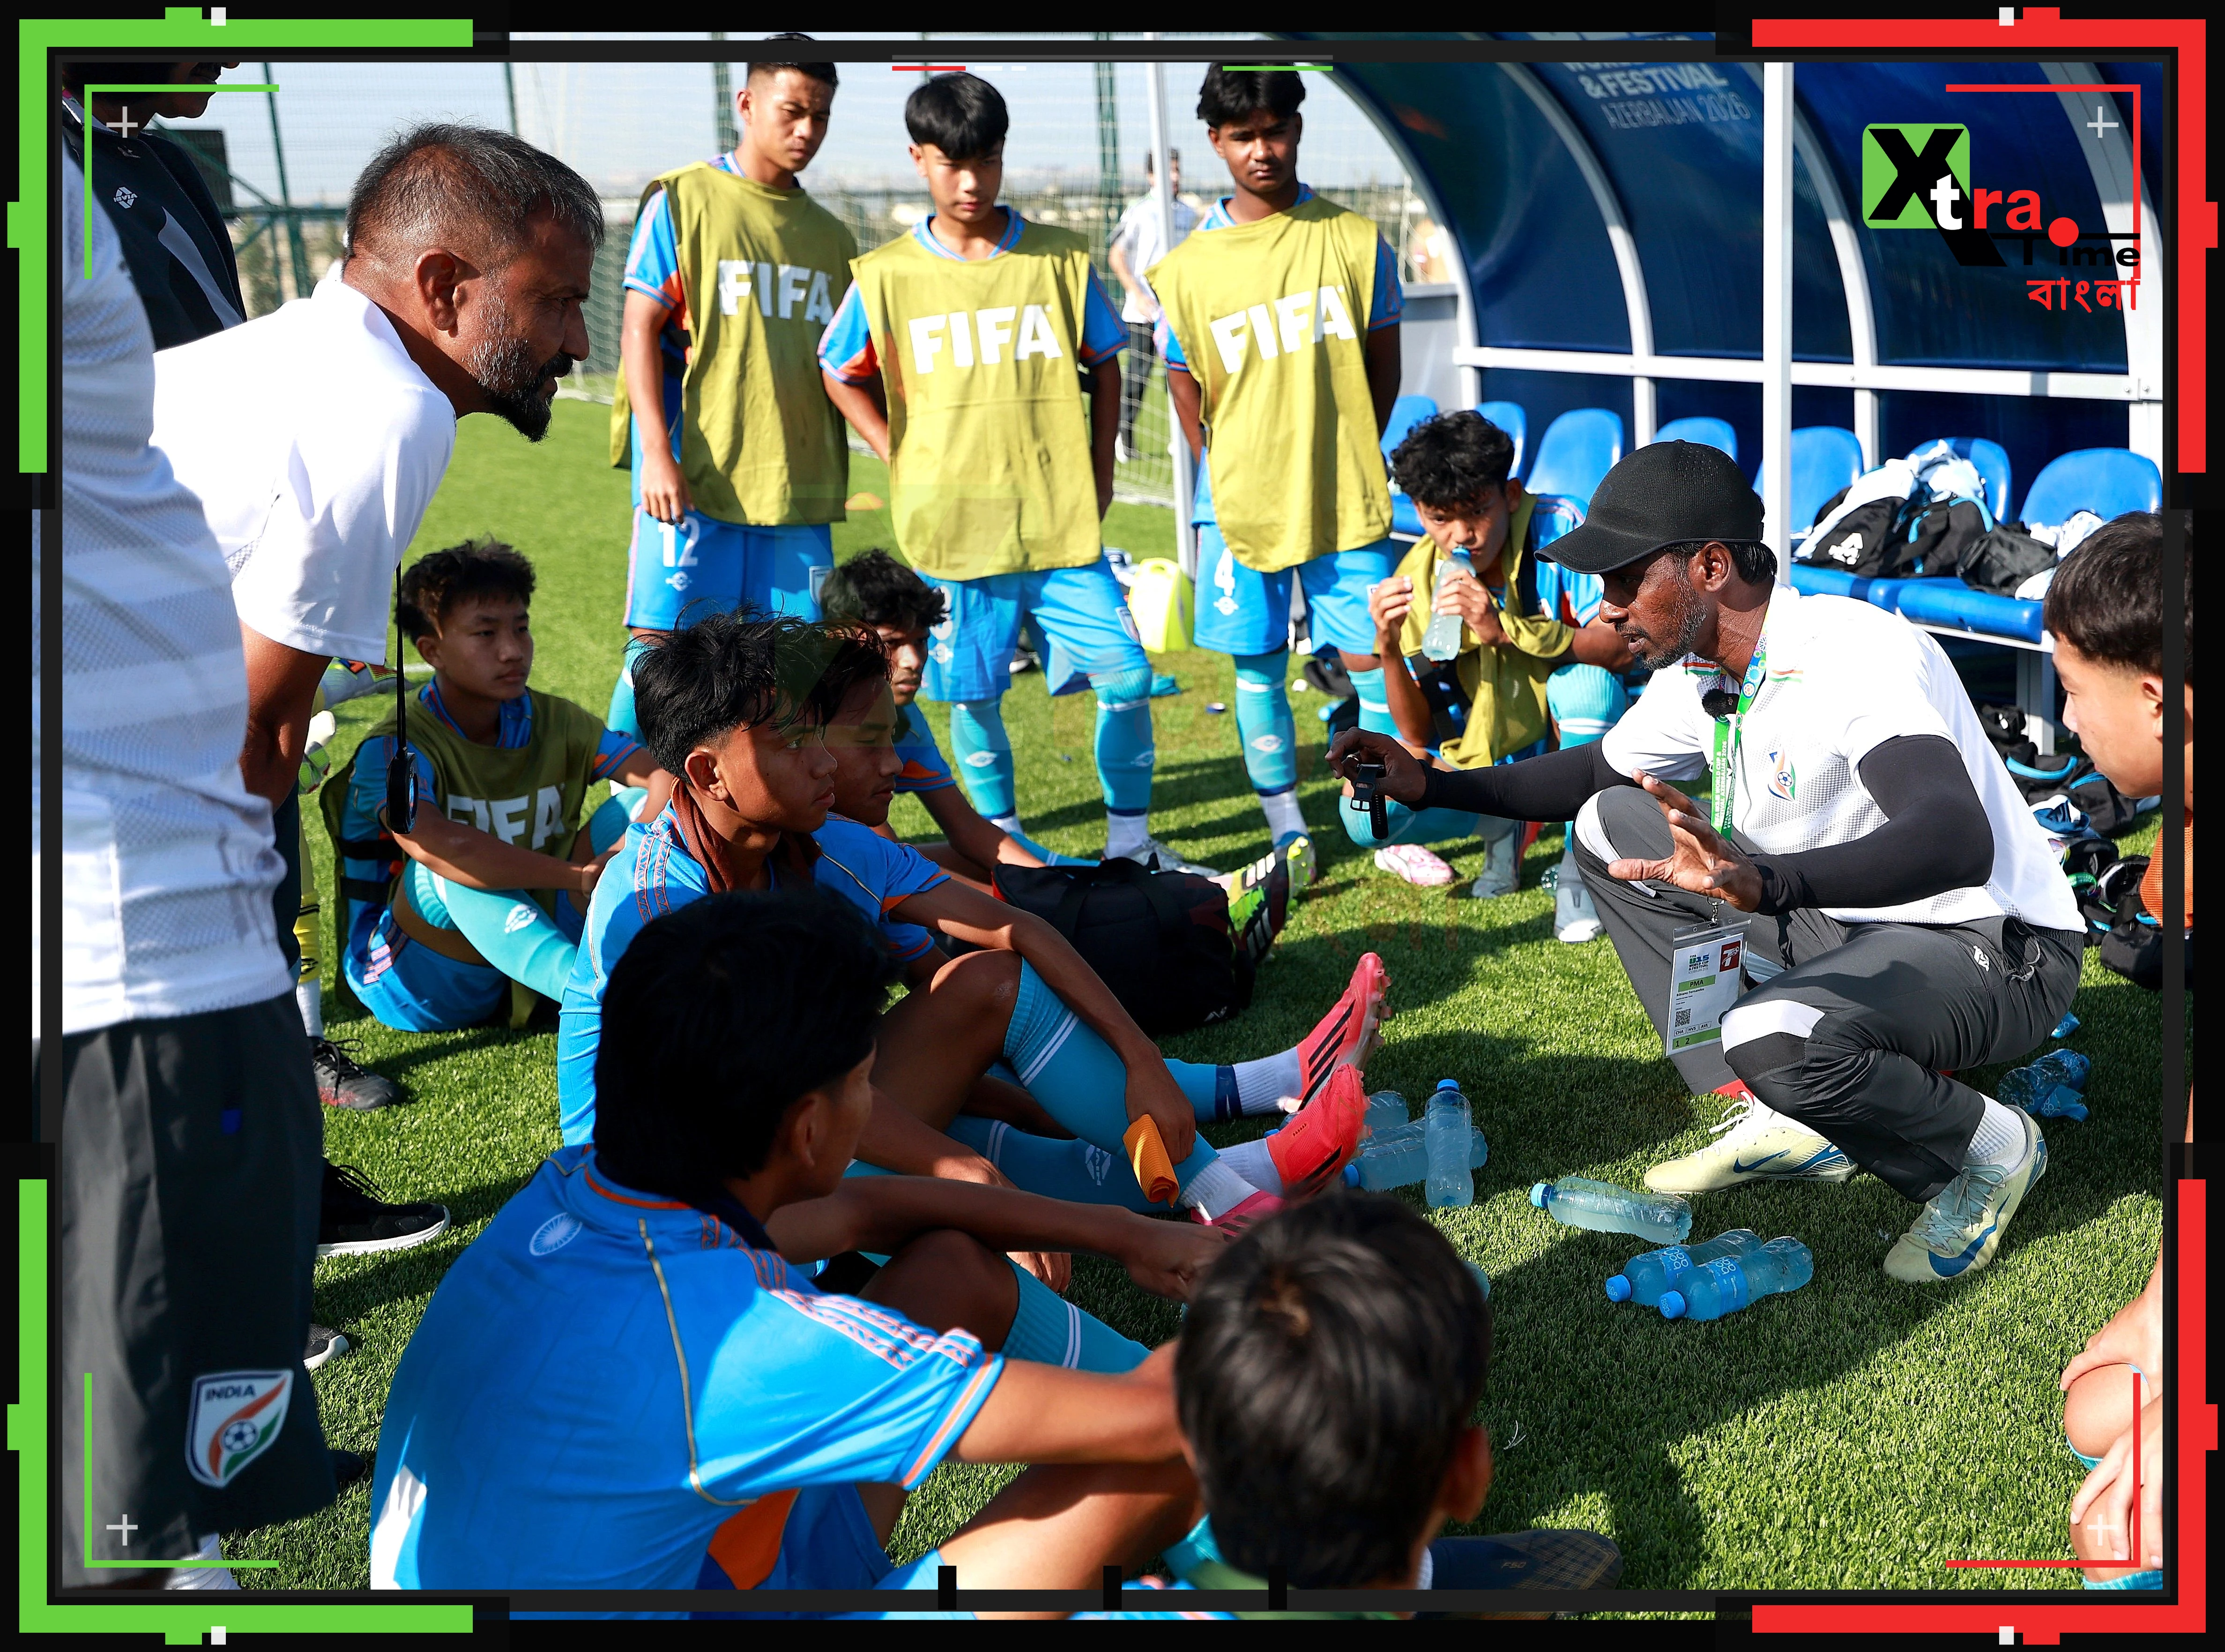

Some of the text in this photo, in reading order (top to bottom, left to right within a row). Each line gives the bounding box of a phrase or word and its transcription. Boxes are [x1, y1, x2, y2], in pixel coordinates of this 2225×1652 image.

[717, 259, 835, 326] FIFA
[908, 304, 1063, 374] FIFA
[1209, 286, 1357, 373] FIFA
[657, 517, 699, 567] 12
[1214, 547, 1235, 597] 4
[205, 1384, 256, 1401] INDIA
